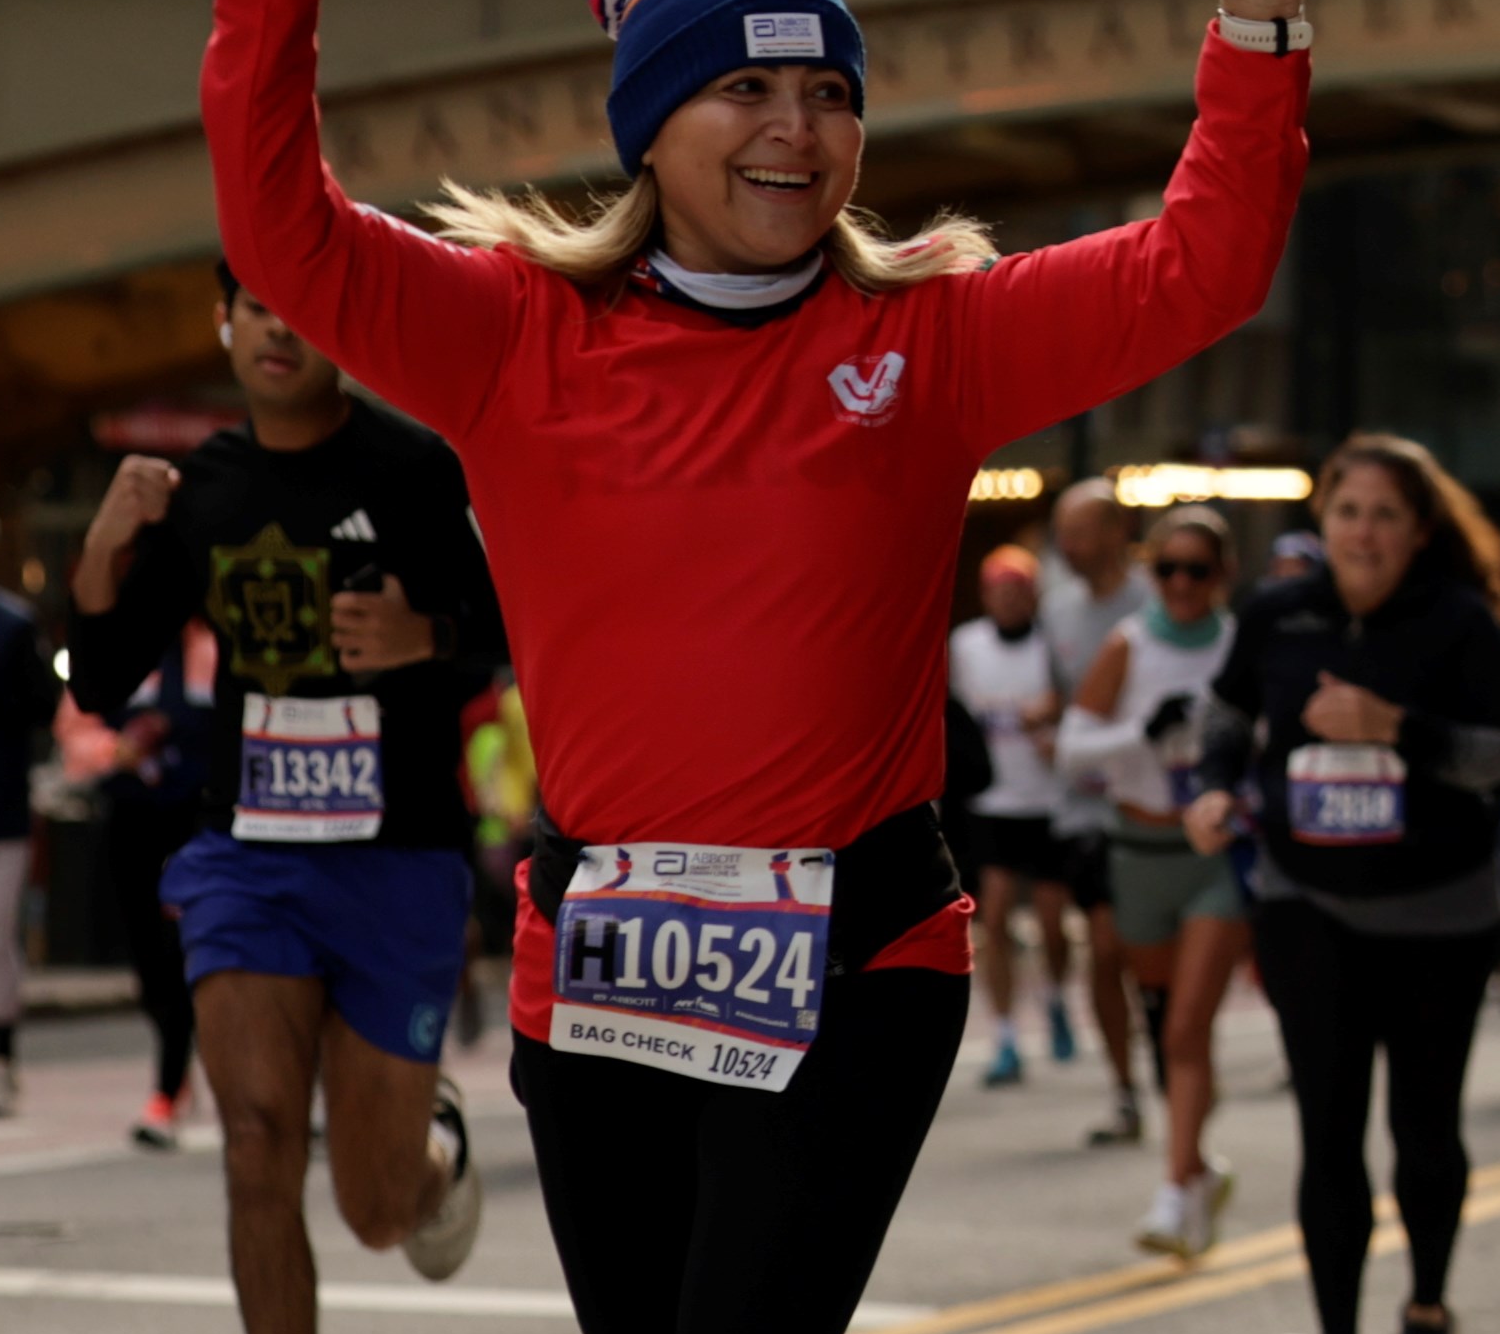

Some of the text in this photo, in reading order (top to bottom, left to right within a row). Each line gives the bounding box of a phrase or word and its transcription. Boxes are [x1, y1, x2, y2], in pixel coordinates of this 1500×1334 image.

[691, 852, 742, 864] ABBOTT
[609, 995, 658, 1007] ABBOTT
[569, 1023, 779, 1082] BAG CHECK 10524
